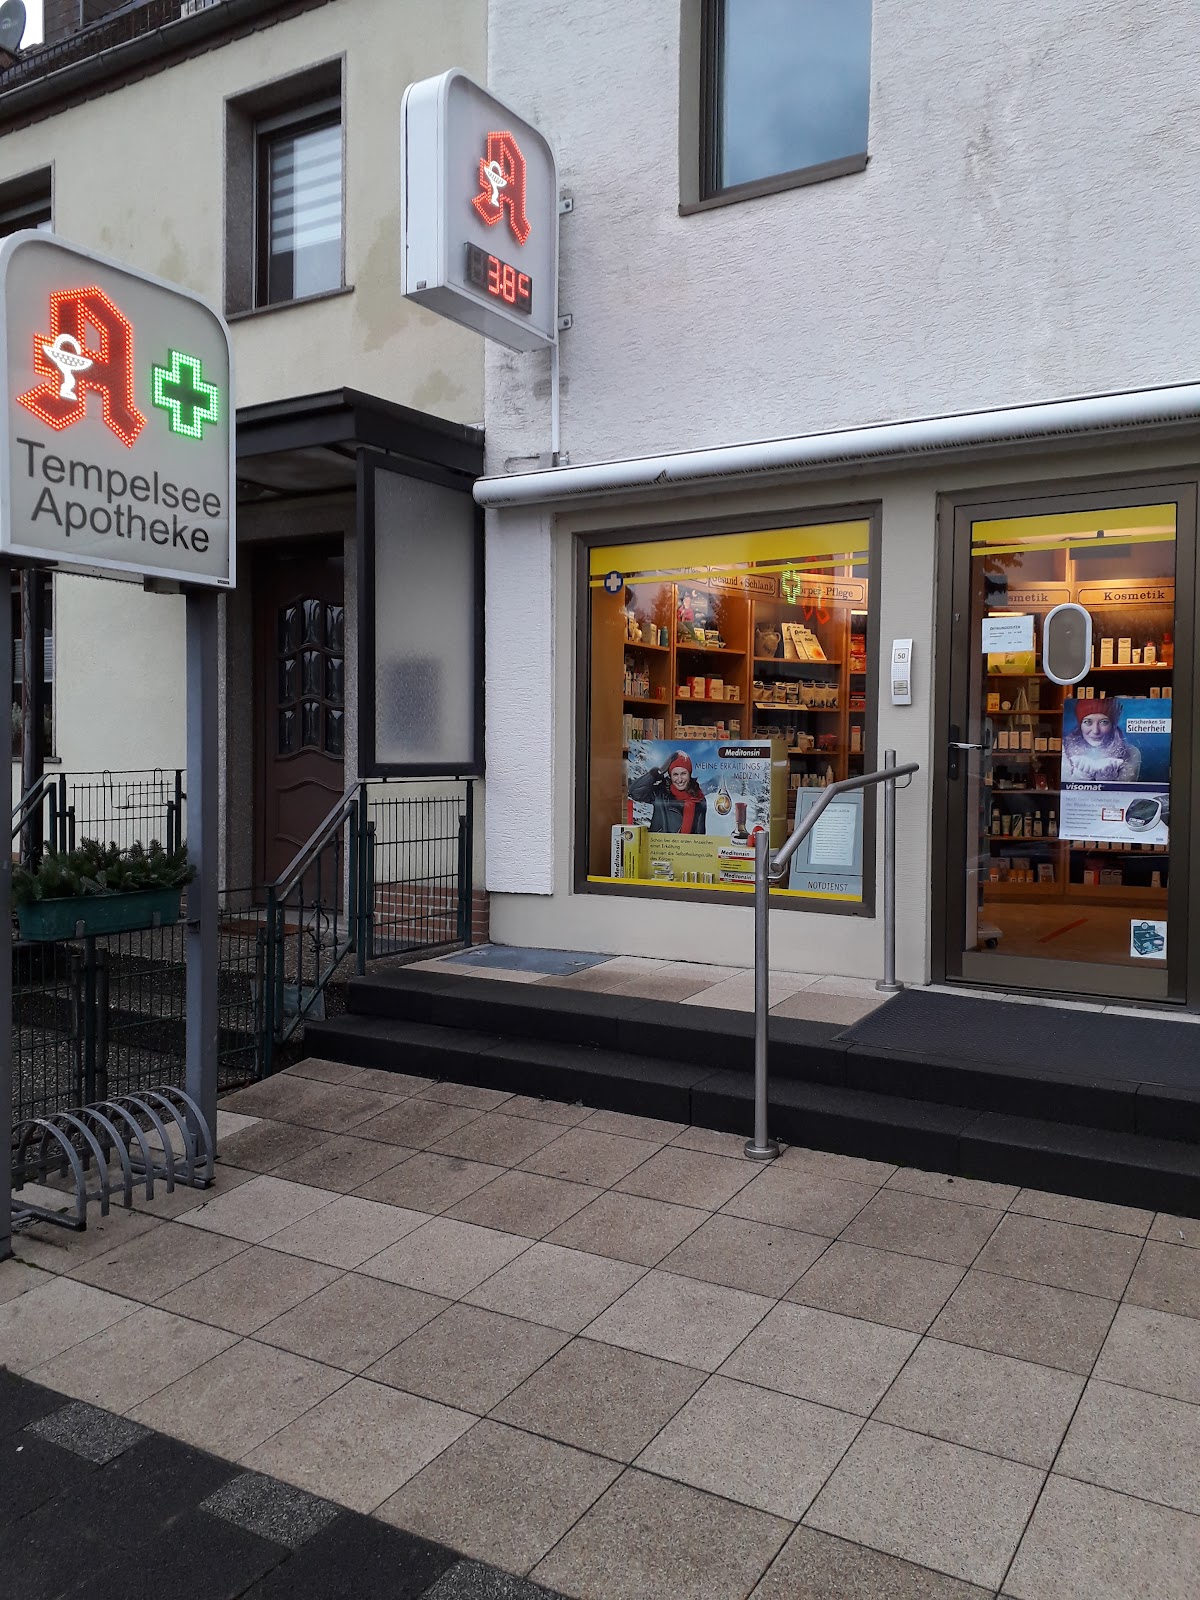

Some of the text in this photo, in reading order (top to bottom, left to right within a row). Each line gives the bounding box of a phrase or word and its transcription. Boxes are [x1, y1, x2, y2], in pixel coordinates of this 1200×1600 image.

[16, 437, 222, 518] Tempelsee
[31, 486, 210, 553] Apotheke
[745, 577, 774, 591] Schlank
[1008, 593, 1049, 602] smetik
[1103, 590, 1165, 601] Kosmetik
[897, 652, 906, 660] 50
[1127, 724, 1166, 732] Sicherheit
[725, 748, 761, 757] Meditonsin
[694, 762, 718, 770] MEINE
[733, 771, 761, 780] MEDIZIN
[1065, 782, 1102, 791] visomat
[720, 849, 750, 857] Meditonsin
[807, 881, 849, 891] NOTDIENST
